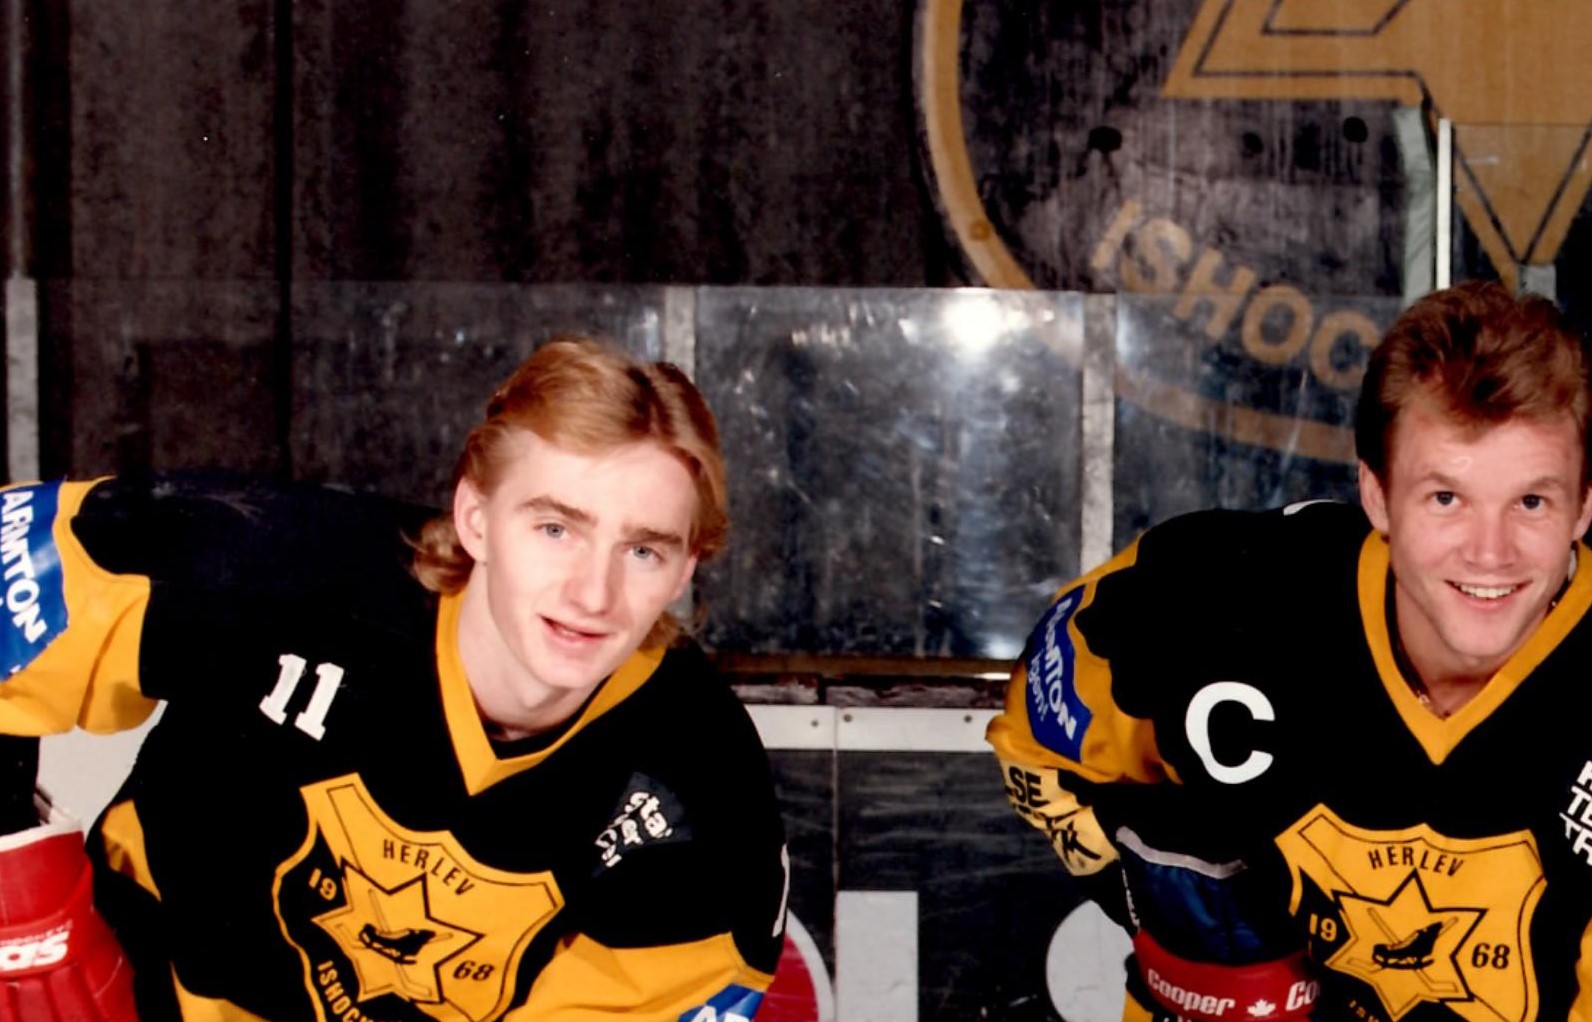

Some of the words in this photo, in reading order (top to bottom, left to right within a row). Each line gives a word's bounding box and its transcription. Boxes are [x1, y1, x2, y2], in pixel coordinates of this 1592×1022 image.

[259, 653, 344, 741] 11
[1186, 681, 1275, 784] C
[383, 838, 476, 896] HERLEV
[1367, 846, 1465, 877] HERLEV
[309, 868, 337, 900] 19
[1309, 913, 1338, 942] 19
[453, 960, 495, 982] 68
[1471, 943, 1511, 970] 68
[1147, 968, 1236, 1017] Cooper
